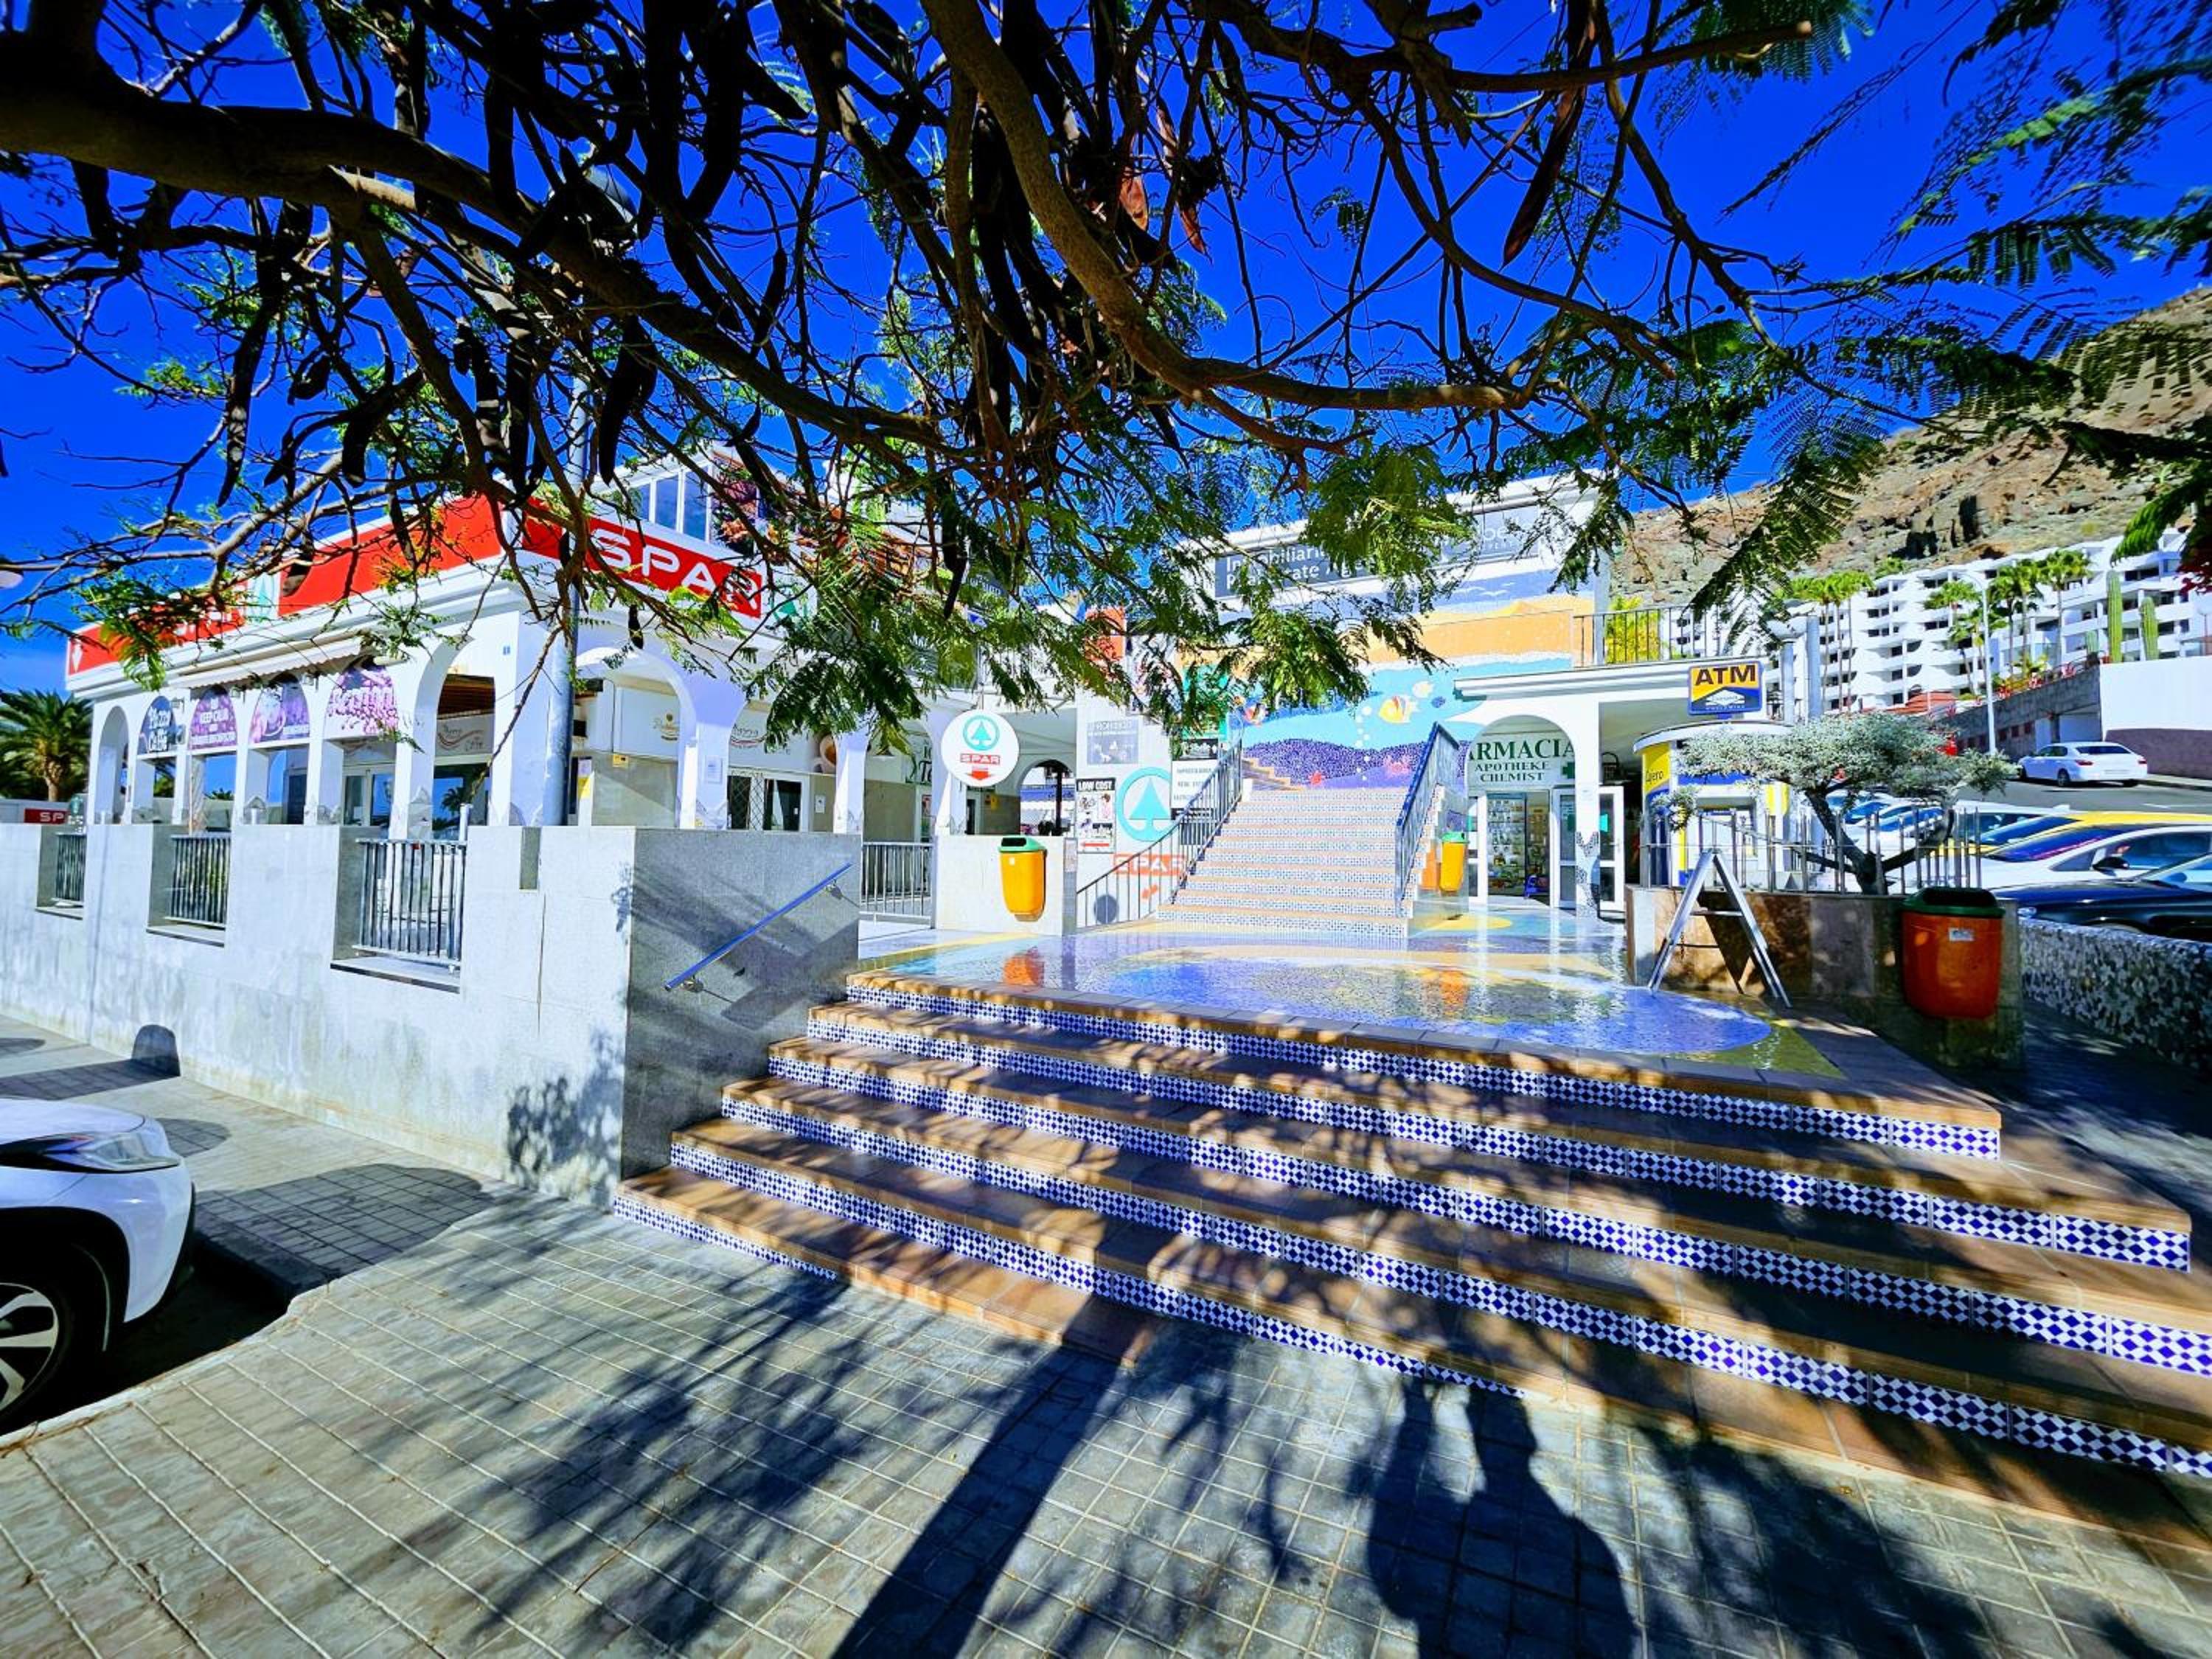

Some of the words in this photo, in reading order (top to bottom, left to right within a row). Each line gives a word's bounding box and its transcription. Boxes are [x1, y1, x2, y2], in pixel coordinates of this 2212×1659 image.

[1695, 665, 1756, 685] ATM
[960, 753, 1001, 765] SPAR
[1475, 761, 1550, 772] APOTHEKE
[1480, 772, 1545, 783] CHEMIST
